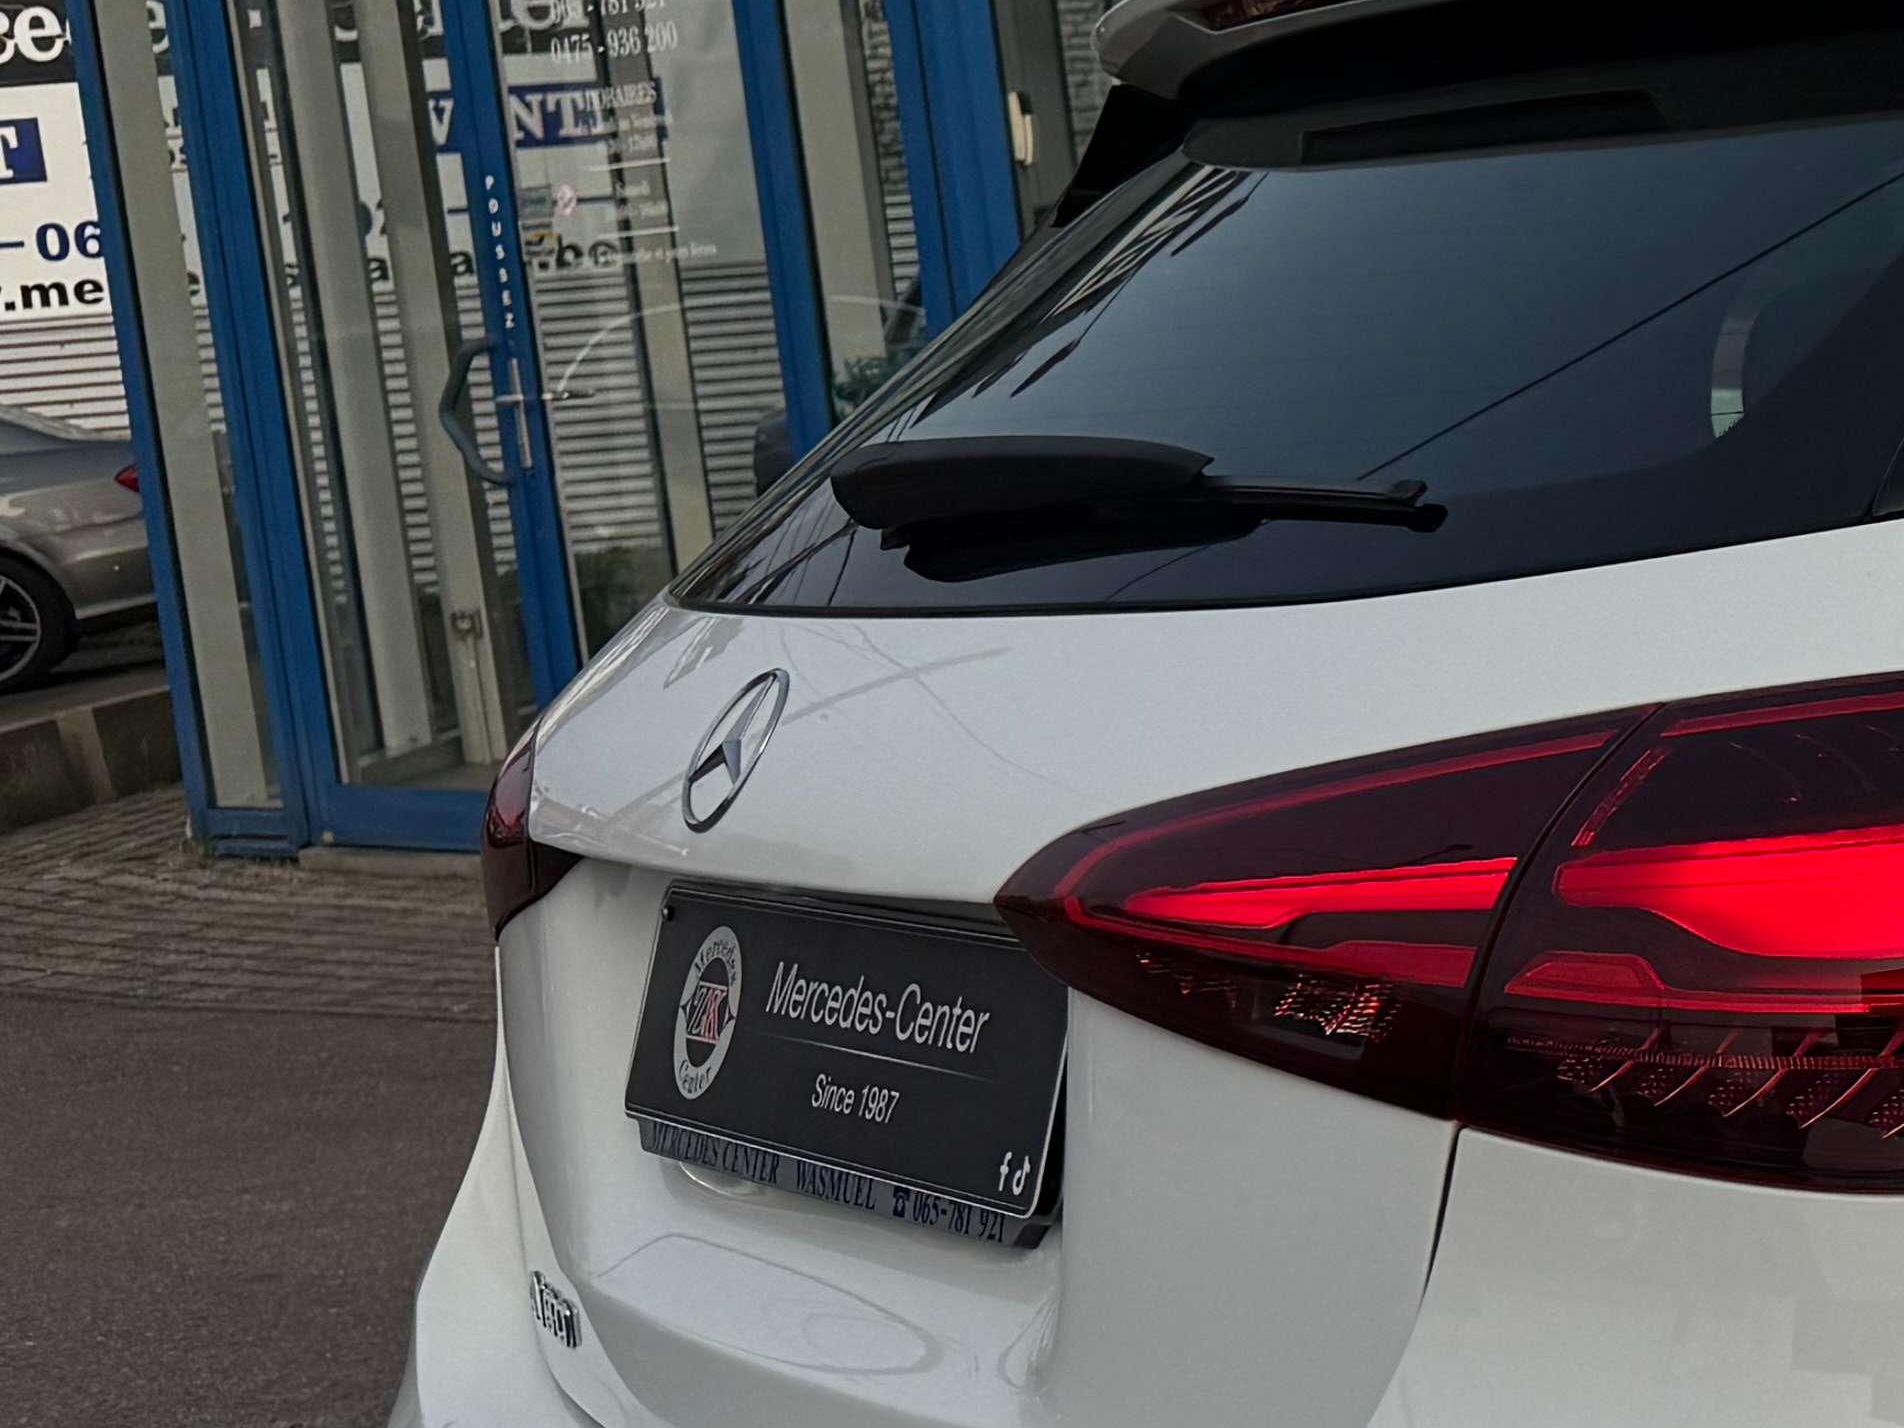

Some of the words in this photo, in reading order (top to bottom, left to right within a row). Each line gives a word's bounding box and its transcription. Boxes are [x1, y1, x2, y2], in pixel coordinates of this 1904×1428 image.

[766, 961, 991, 1053] Mercedes-Center
[811, 1074, 855, 1115] Since
[858, 1084, 900, 1124] 1987
[722, 1138, 780, 1185] CENTER
[796, 1157, 876, 1211] WASMUEL
